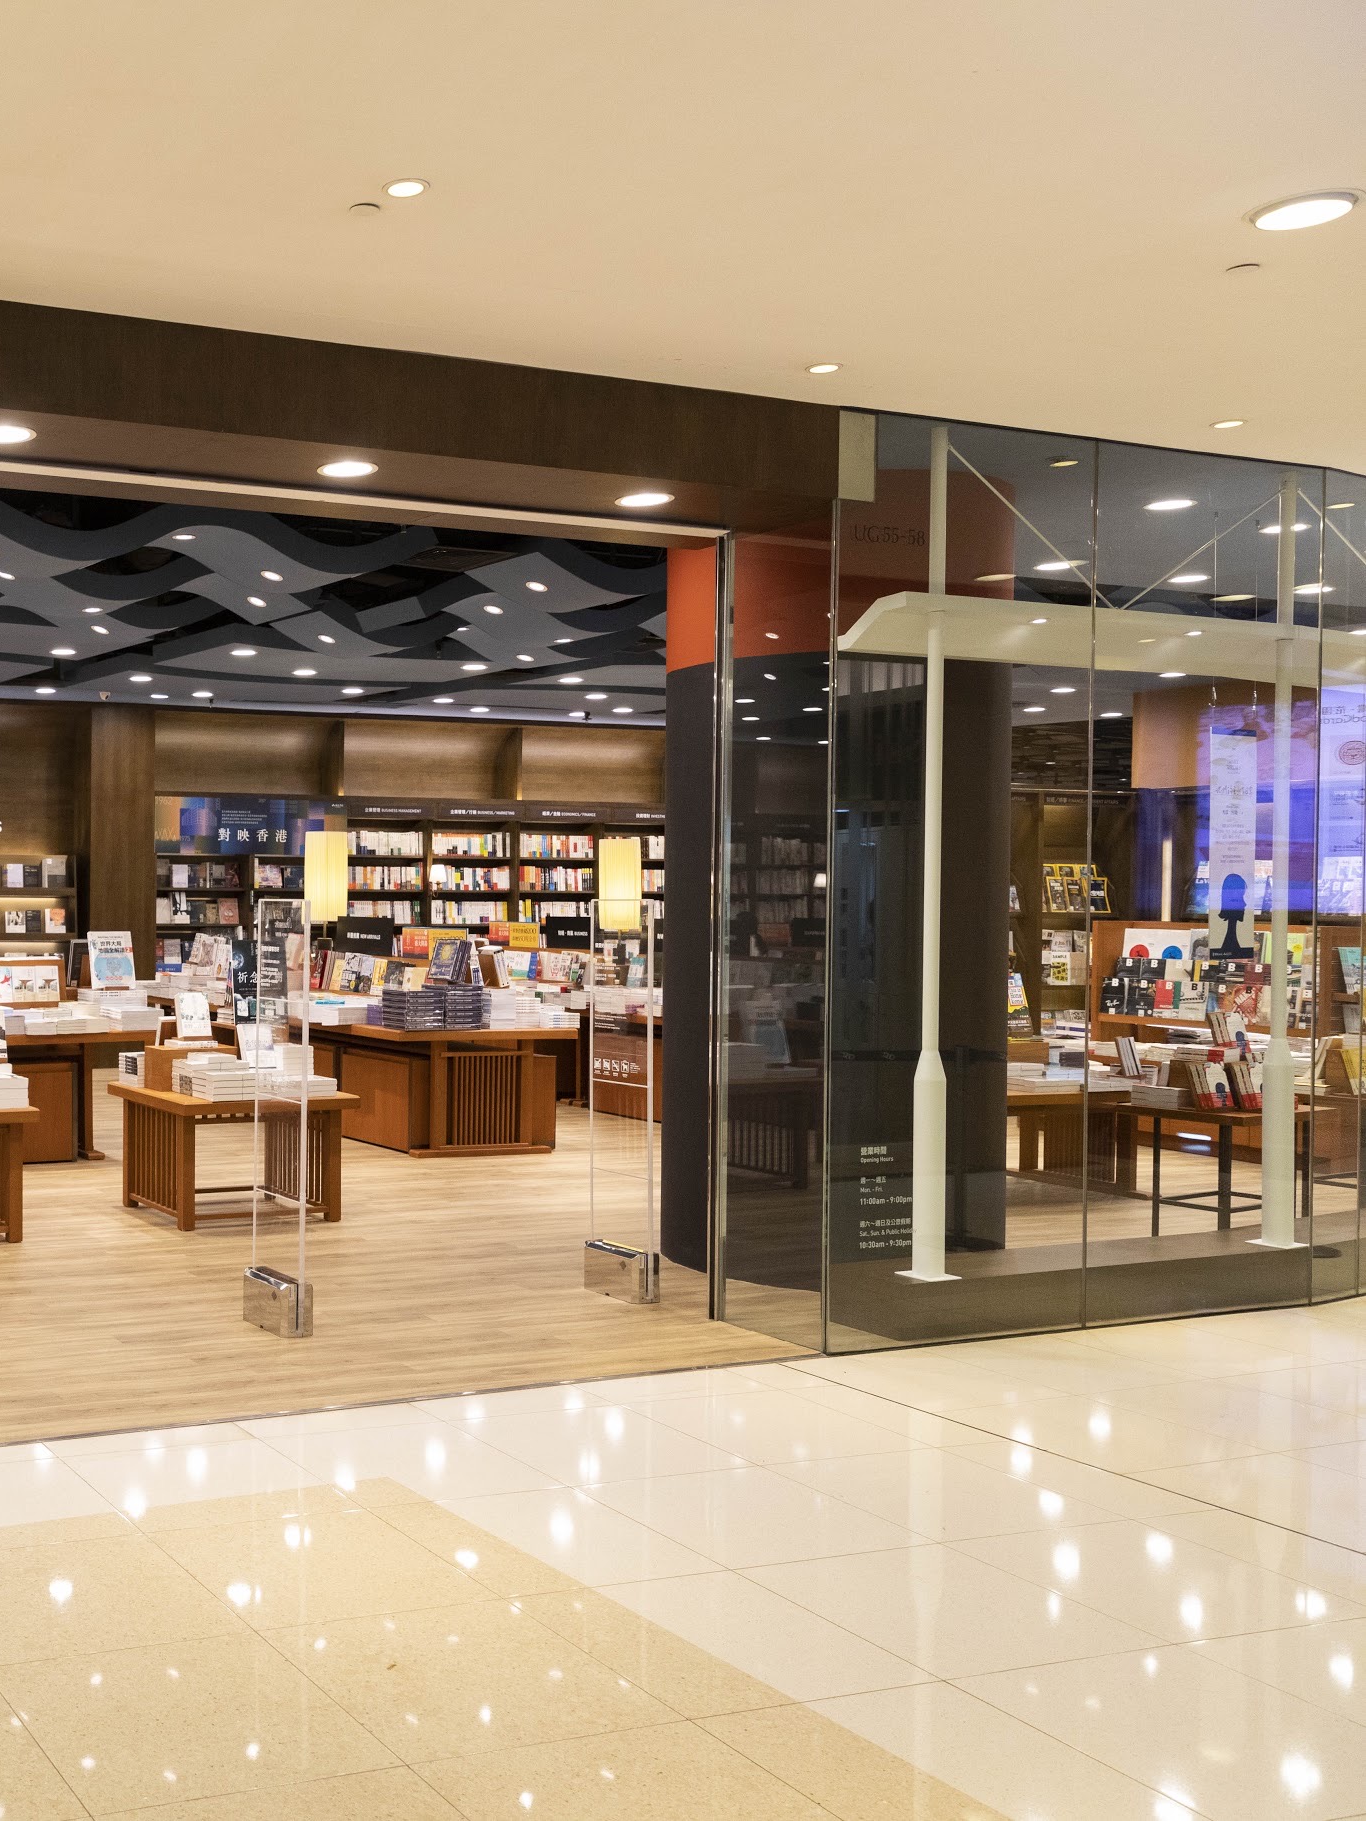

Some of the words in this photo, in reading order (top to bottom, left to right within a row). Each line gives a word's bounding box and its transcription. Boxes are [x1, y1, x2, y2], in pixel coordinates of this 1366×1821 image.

[218, 828, 288, 844] 對映香港
[890, 1196, 912, 1204] 9:00pm
